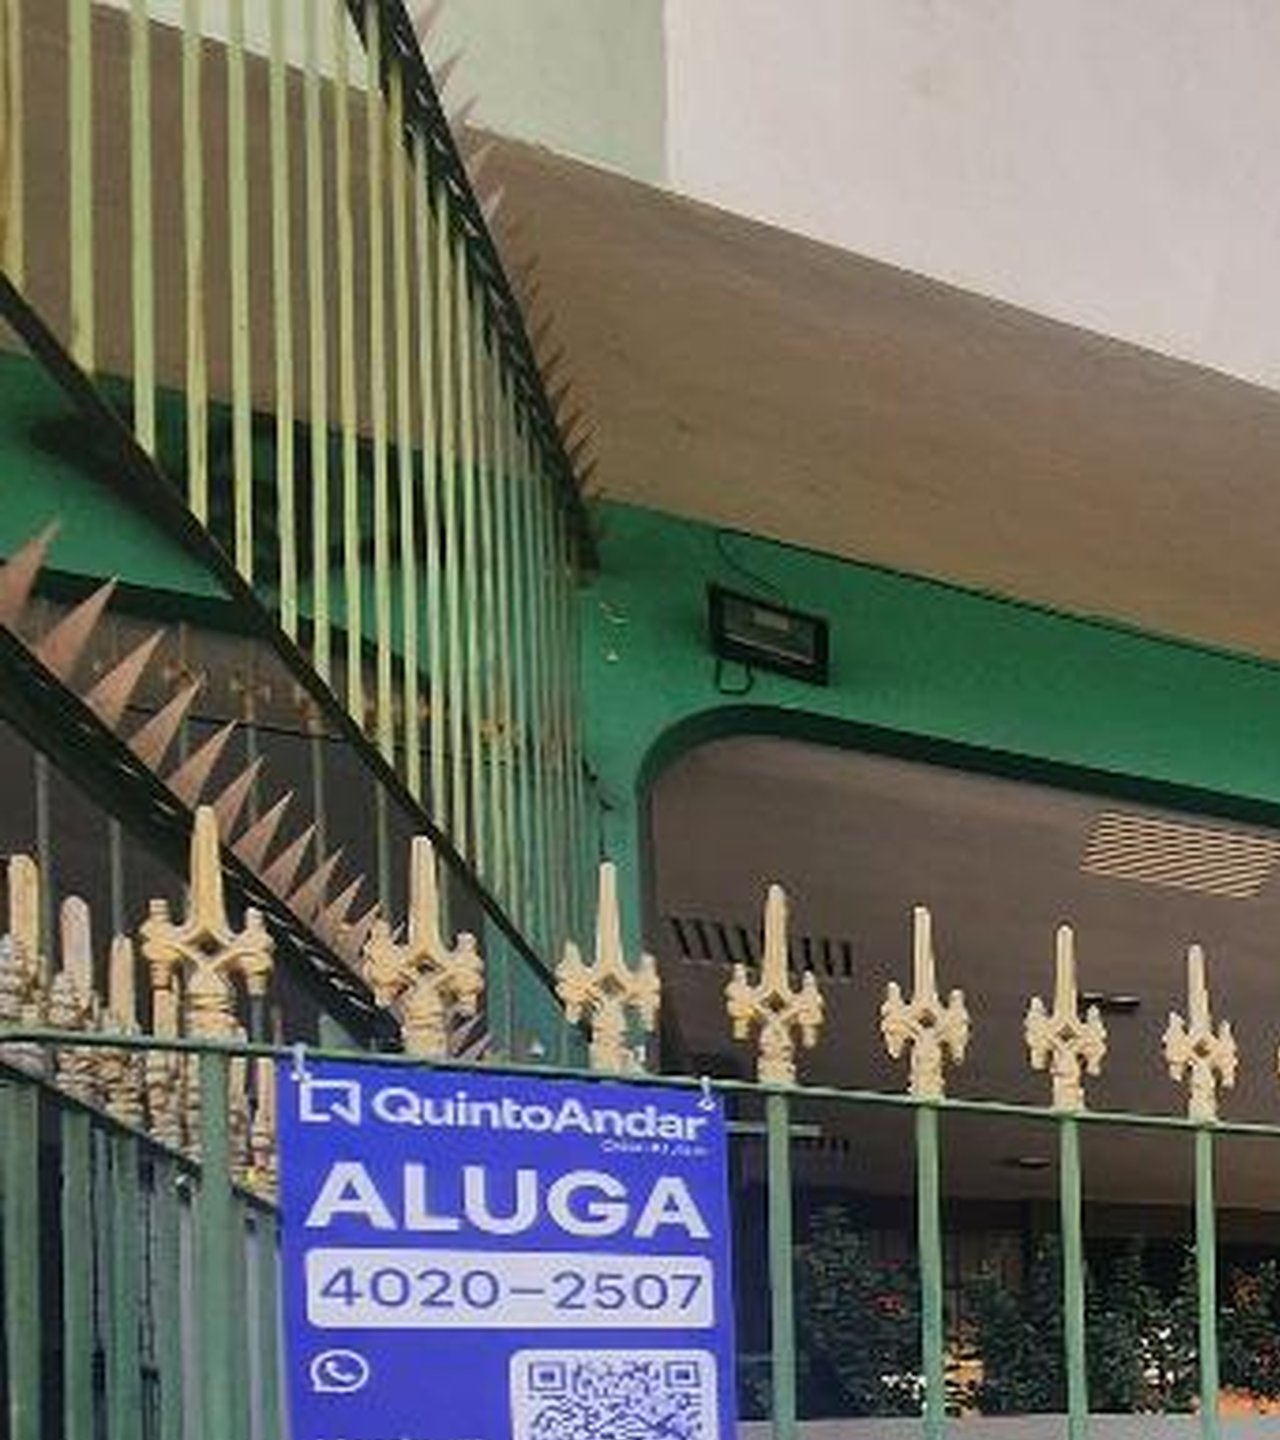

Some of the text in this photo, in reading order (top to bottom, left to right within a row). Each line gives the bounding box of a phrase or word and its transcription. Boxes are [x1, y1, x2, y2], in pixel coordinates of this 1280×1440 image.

[371, 1087, 707, 1141] QuintoAndar
[305, 1161, 711, 1239] ALUGA
[319, 1267, 703, 1312] 4020-2507
